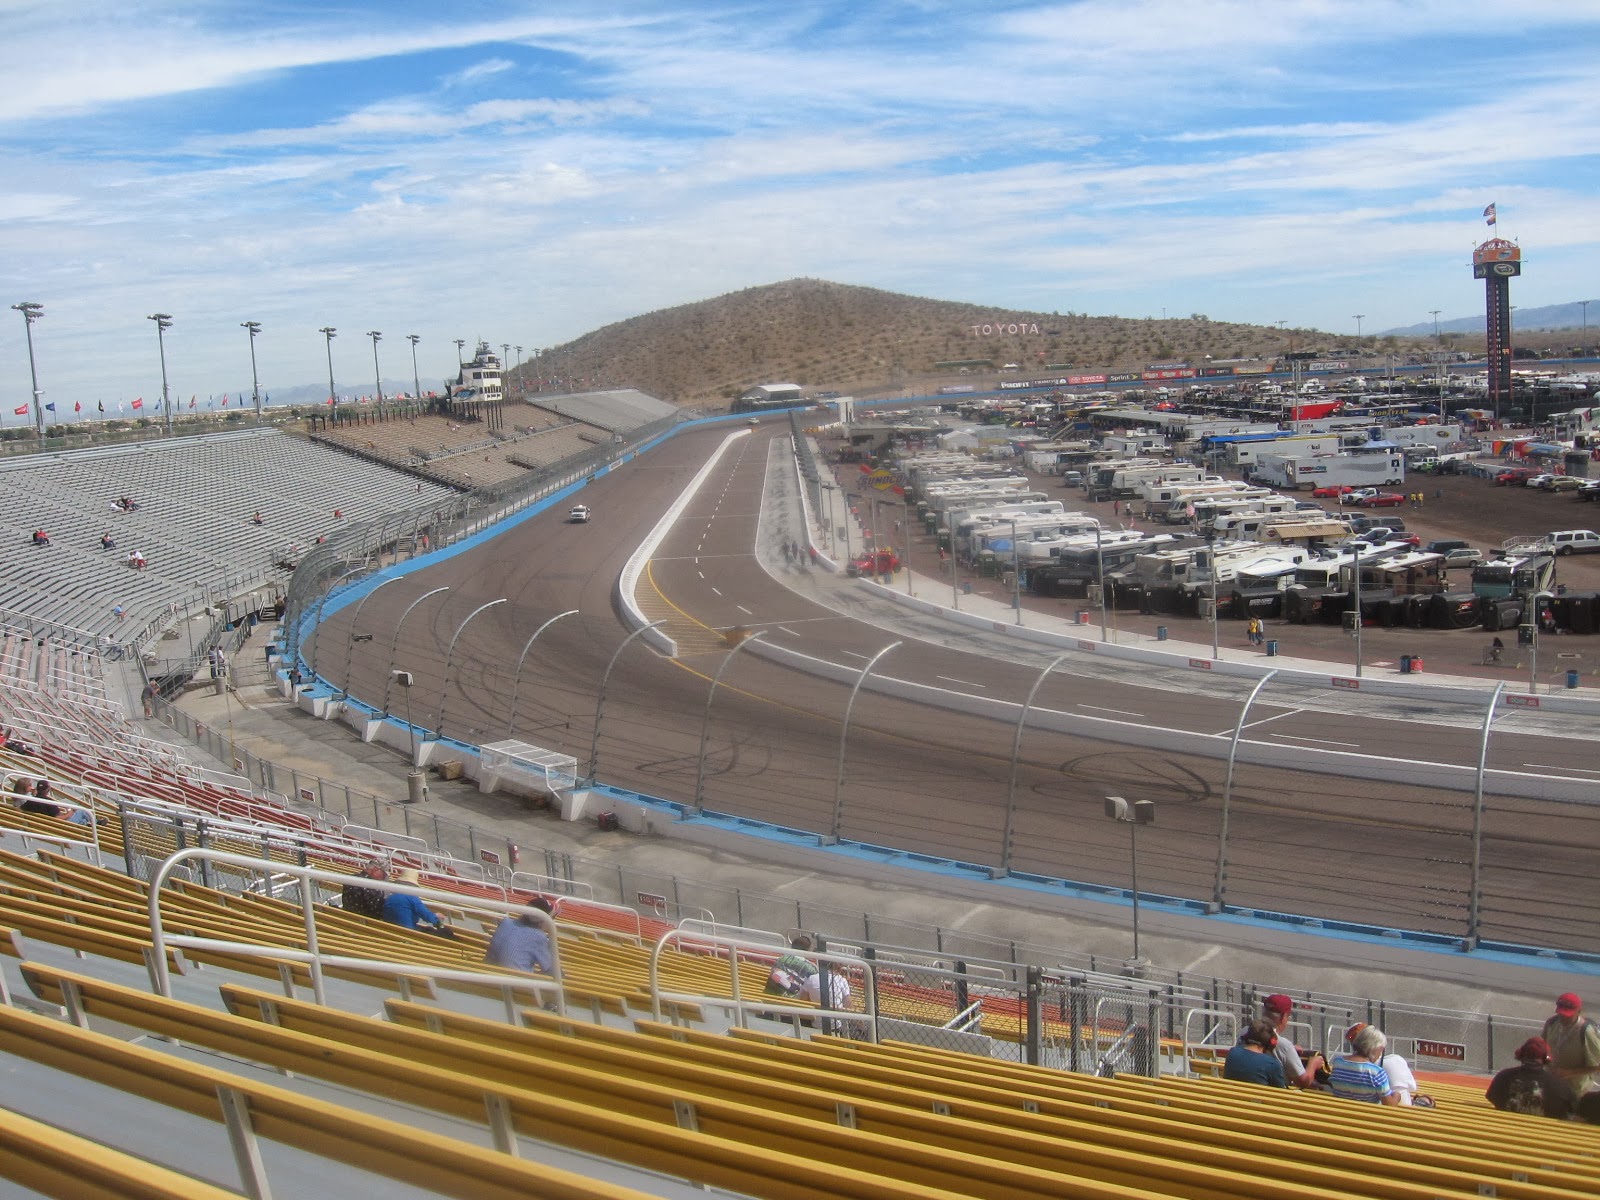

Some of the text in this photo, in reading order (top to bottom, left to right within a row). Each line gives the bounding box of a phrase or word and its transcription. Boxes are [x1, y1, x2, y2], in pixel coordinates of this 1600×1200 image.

[971, 323, 1040, 336] TOYOTA
[1110, 374, 1130, 382] Sprint
[1001, 381, 1030, 389] PROFIT
[861, 473, 905, 486] SUNOCO
